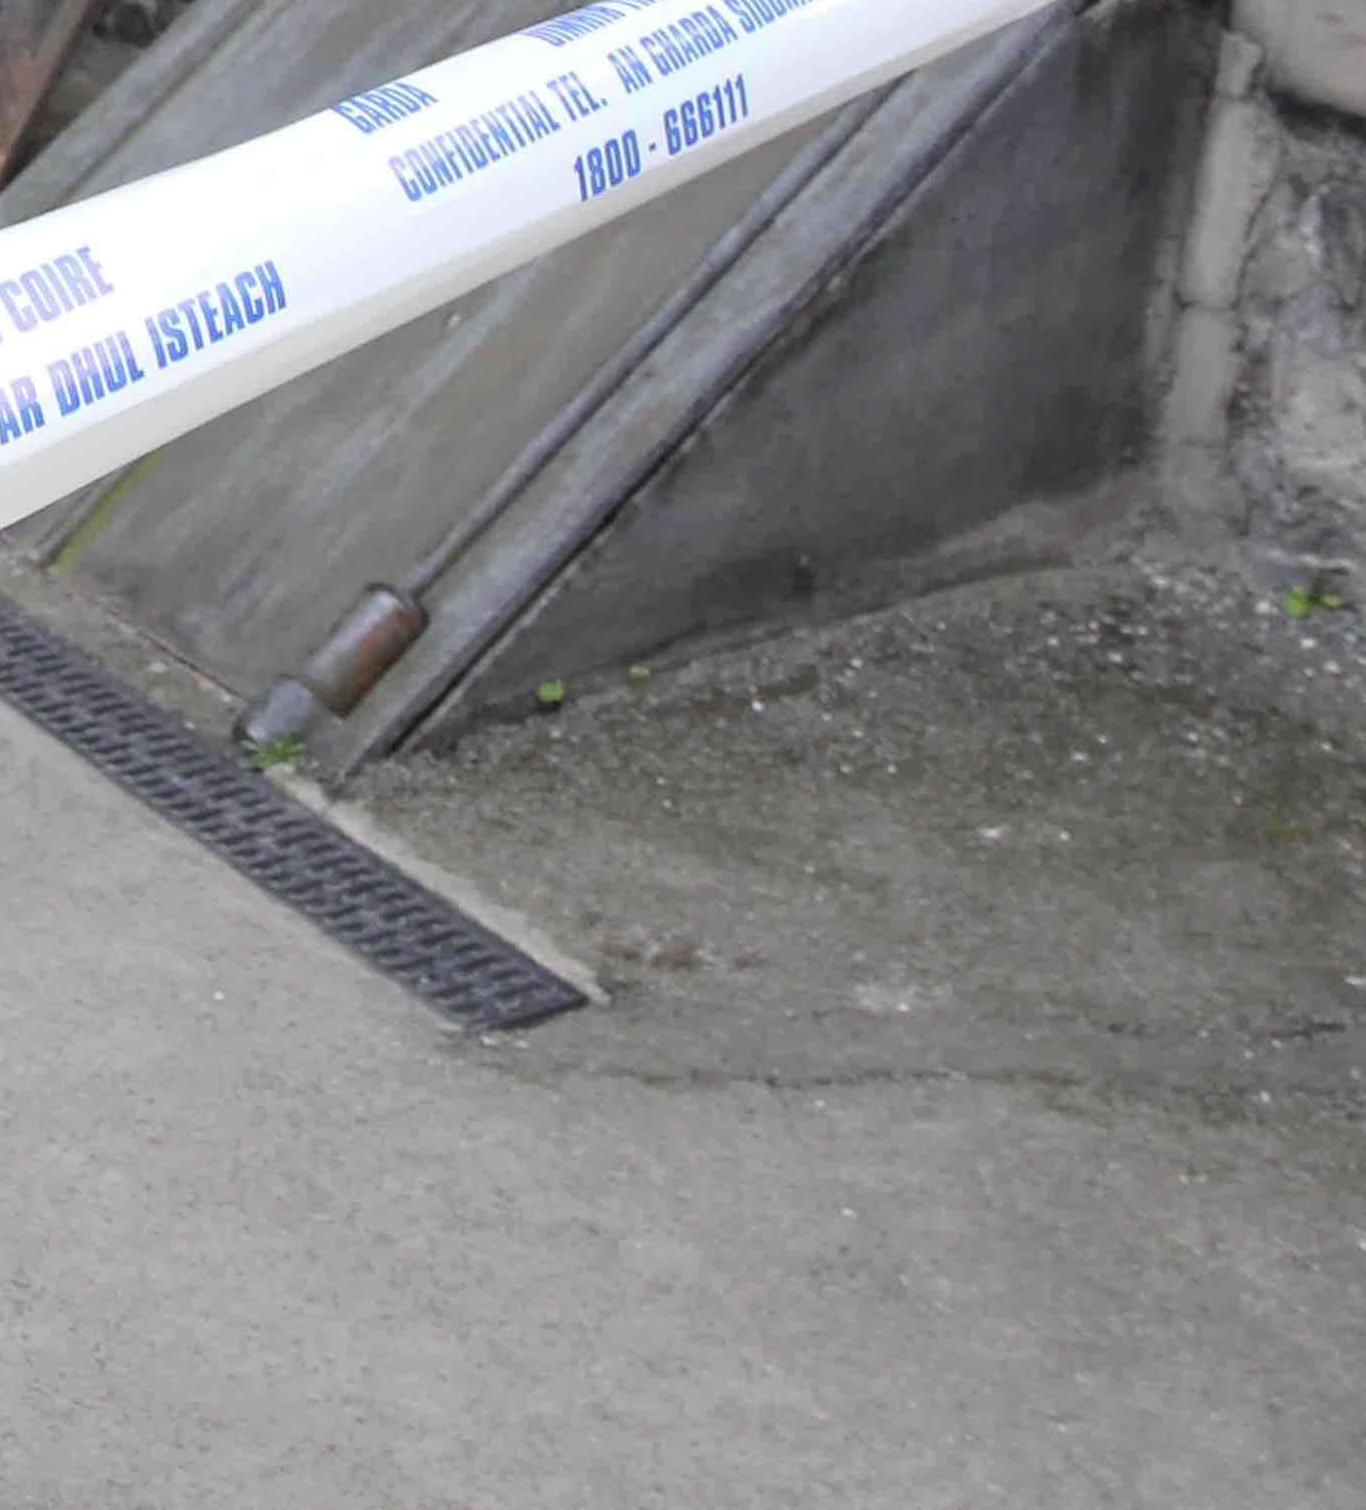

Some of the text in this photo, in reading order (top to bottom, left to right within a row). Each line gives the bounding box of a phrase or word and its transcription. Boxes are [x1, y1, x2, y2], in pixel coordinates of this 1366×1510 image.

[329, 81, 438, 134] GARDA
[607, 45, 653, 94] AN
[640, 4, 738, 77] GHARDA
[388, 71, 608, 202] CONFIDENTIAL TEL.
[574, 130, 642, 202] 1800
[666, 74, 749, 157] 666111
[47, 330, 145, 416] DHUL
[144, 260, 288, 370] ISTEACH
